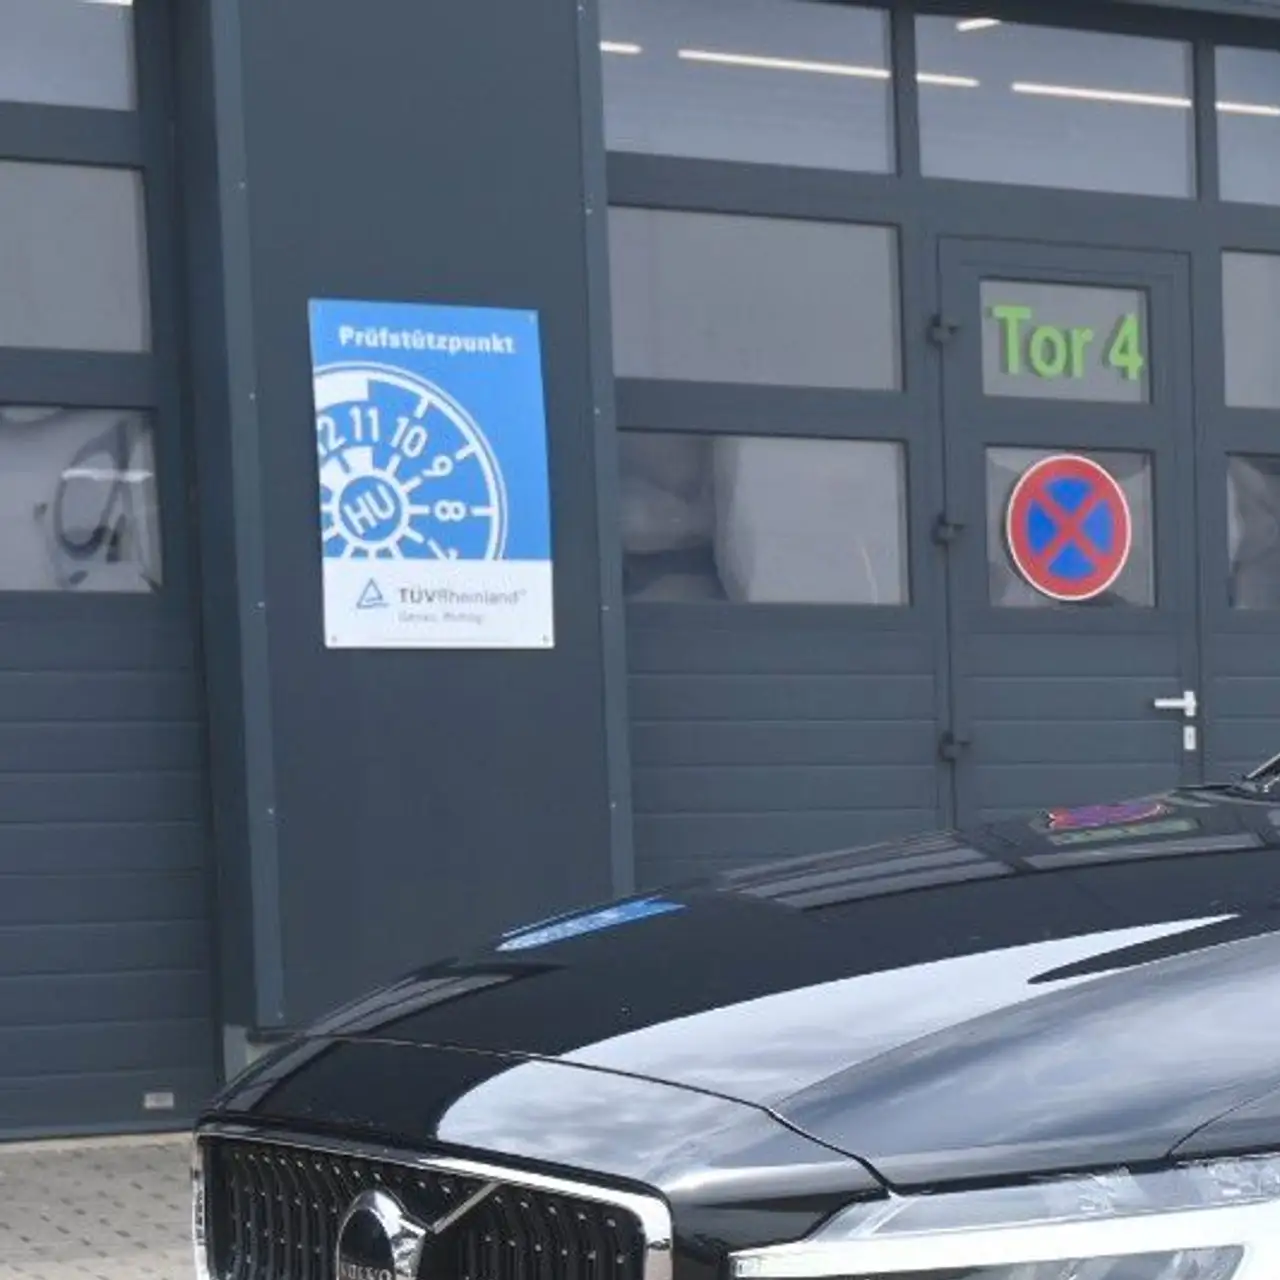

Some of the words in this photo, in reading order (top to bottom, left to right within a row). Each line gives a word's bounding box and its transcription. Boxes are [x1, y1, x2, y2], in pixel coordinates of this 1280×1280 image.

[338, 326, 516, 354] Prüfstützpunkt
[992, 305, 1093, 379] Tor
[1109, 312, 1143, 380] 4
[350, 406, 379, 443] 11
[390, 416, 427, 458] 10
[422, 455, 453, 476] 9
[343, 484, 395, 536] HU
[434, 500, 466, 521] 8
